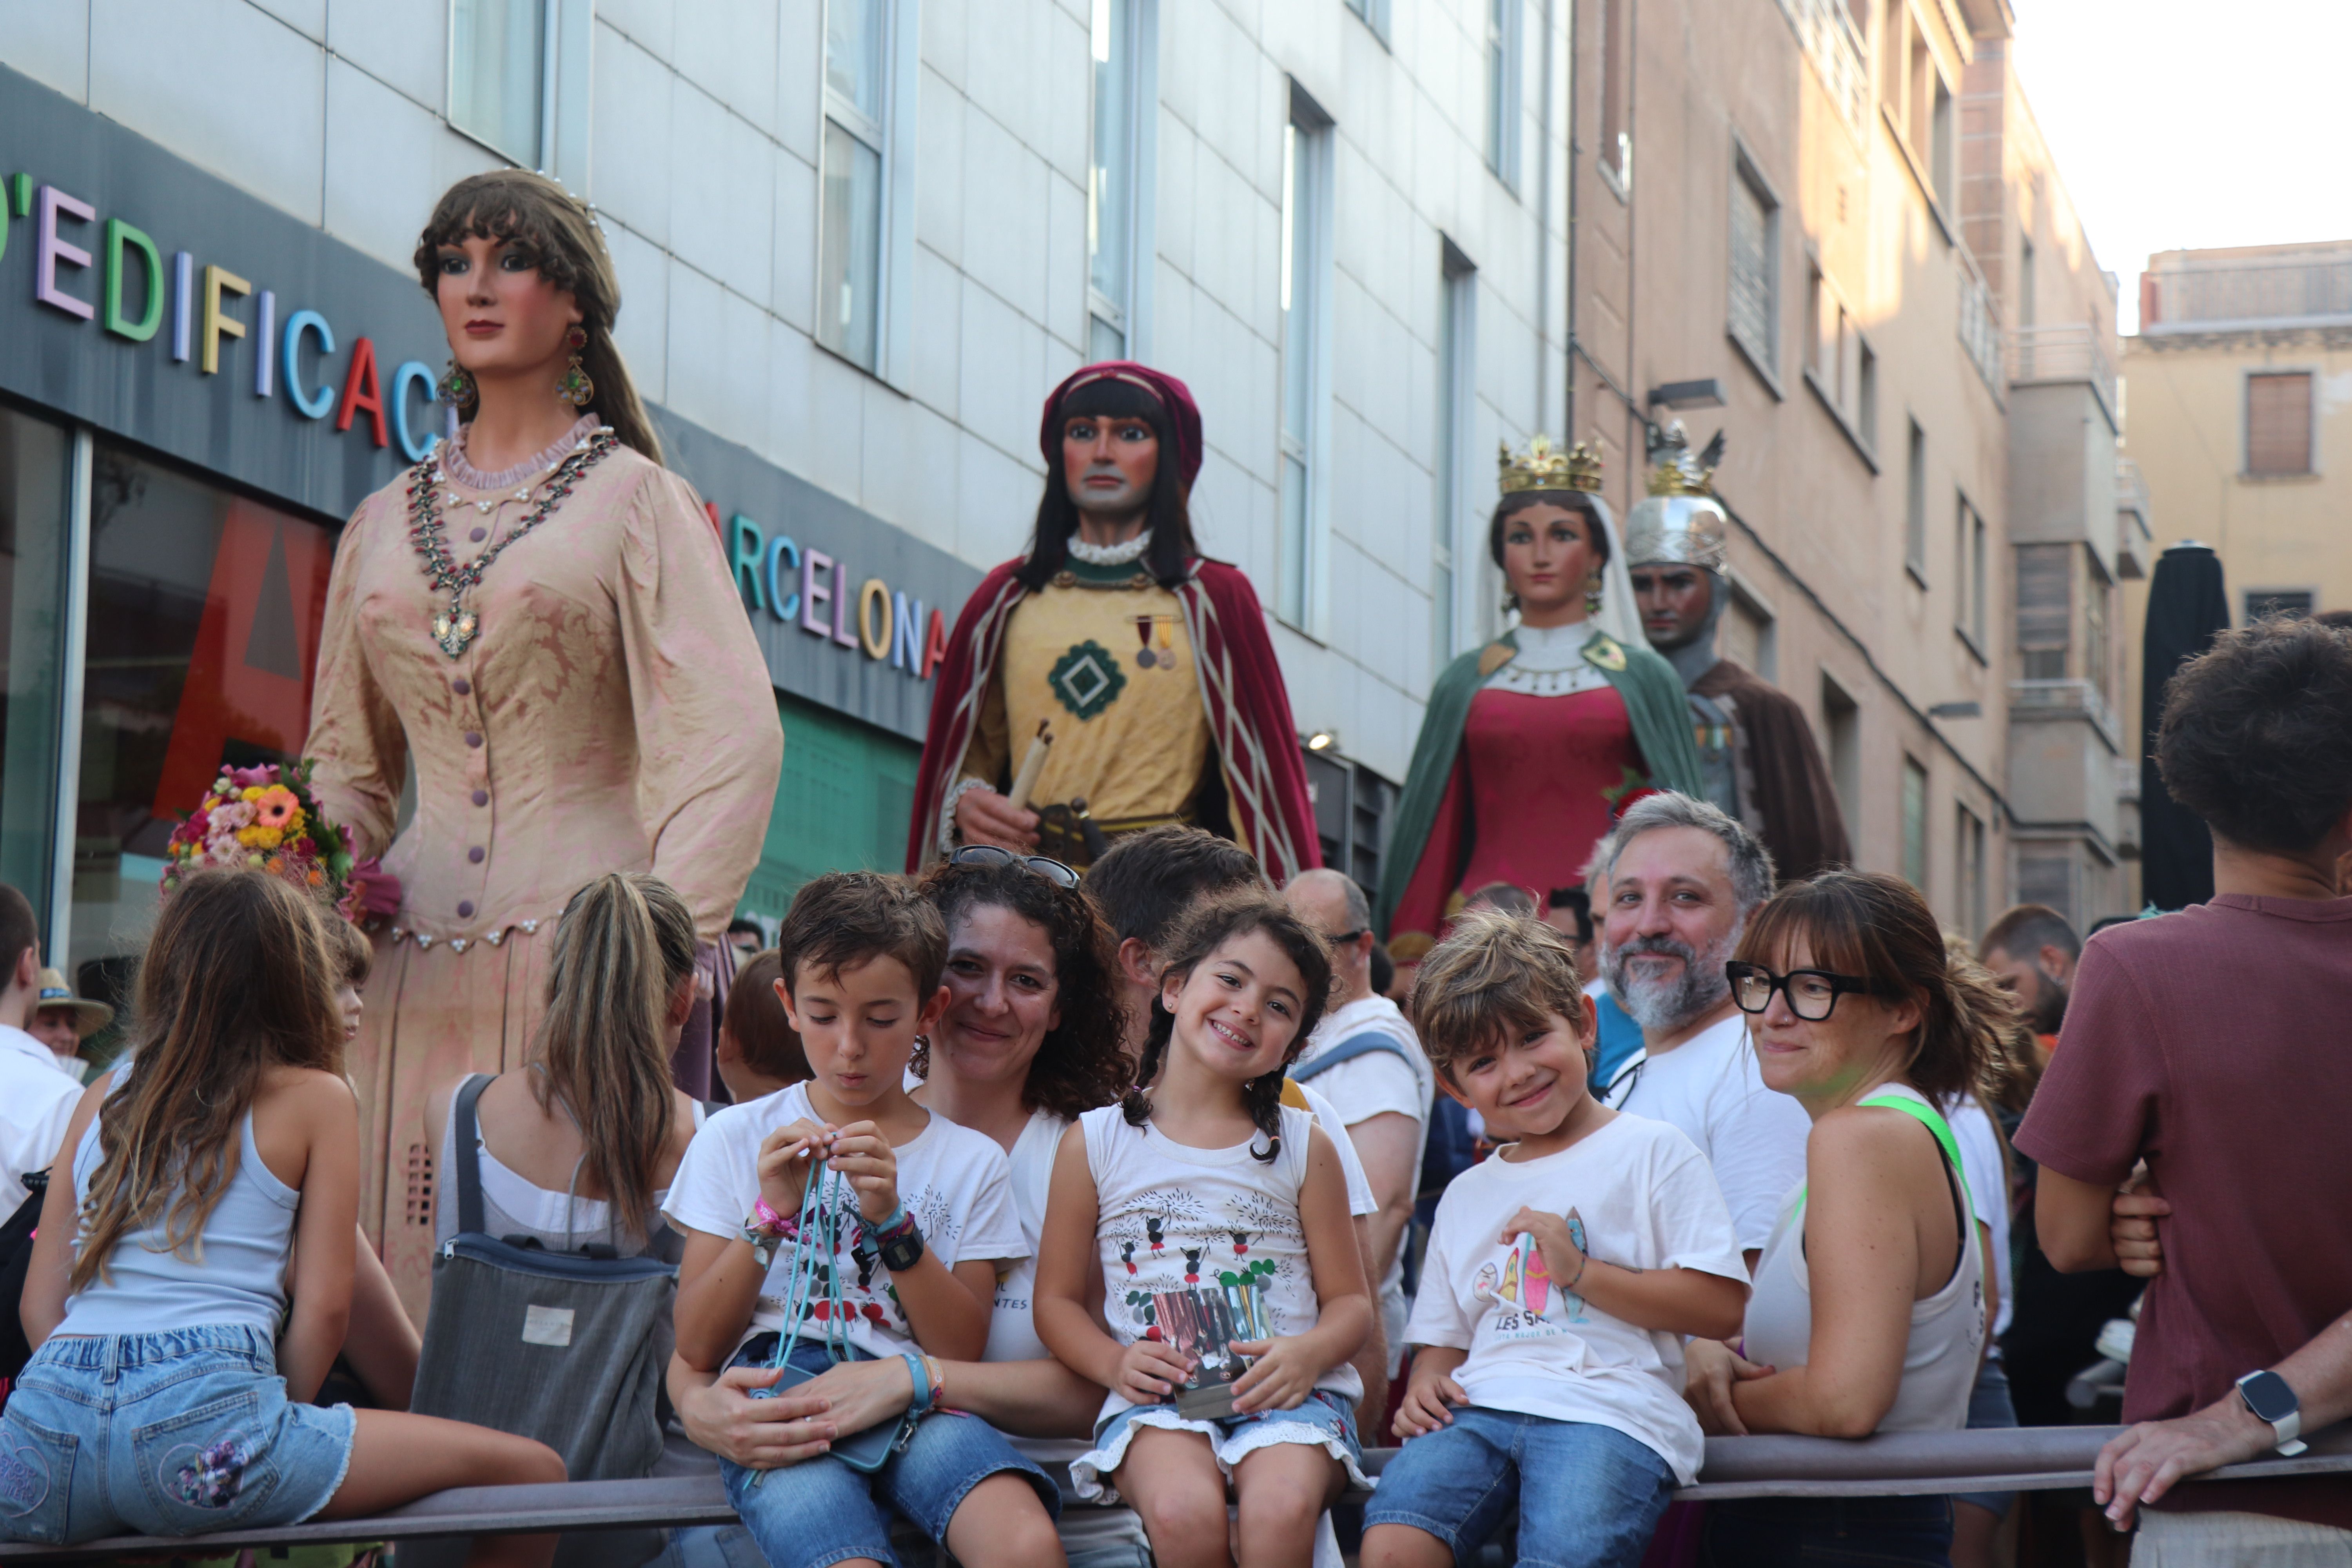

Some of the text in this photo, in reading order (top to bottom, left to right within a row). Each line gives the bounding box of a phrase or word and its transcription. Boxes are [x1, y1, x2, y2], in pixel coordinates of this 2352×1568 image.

[0, 169, 947, 680] 'EDIFICAC RCELONA
[1495, 1313, 1519, 1331] LES
[1515, 1330, 1541, 1339] MAJOR
